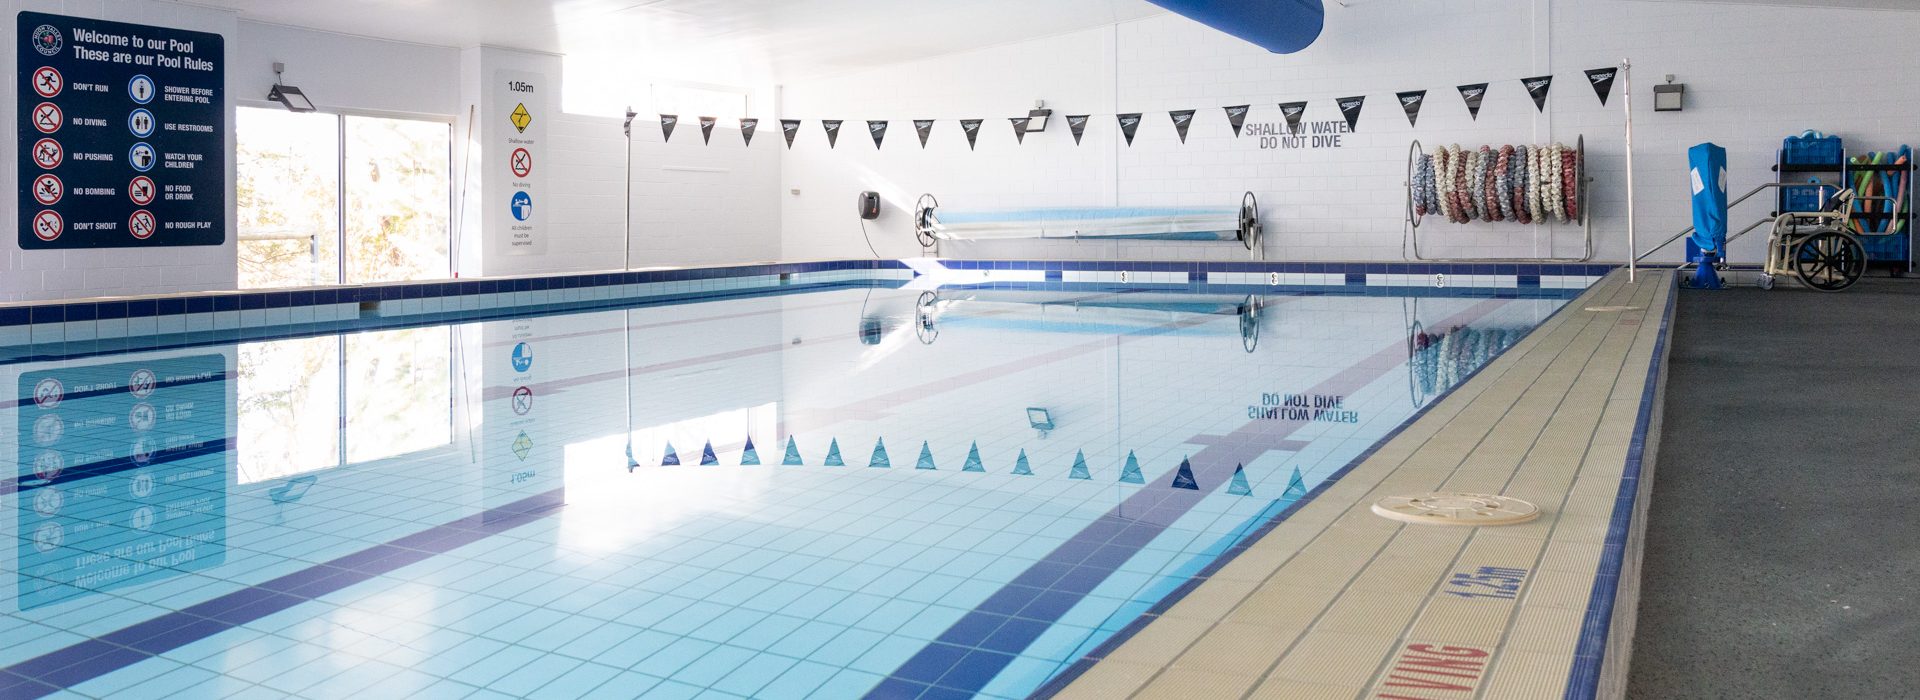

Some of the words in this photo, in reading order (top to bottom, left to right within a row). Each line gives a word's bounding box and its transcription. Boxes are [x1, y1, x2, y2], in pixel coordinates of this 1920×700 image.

[46, 26, 62, 41] VALLEY
[73, 28, 129, 46] Welcome
[132, 35, 144, 48] to
[148, 39, 167, 51] our
[170, 38, 194, 53] Pool
[36, 44, 60, 54] COUNCIL
[74, 46, 110, 61] These
[113, 51, 132, 64] are
[136, 54, 154, 66] our
[158, 55, 181, 69] Pool
[184, 57, 214, 71] Rules
[1590, 72, 1612, 80] speedo
[74, 82, 92, 92] DON'T
[95, 84, 108, 92] RUN
[165, 86, 189, 95] SHOWER
[191, 87, 214, 96] BEFORE
[508, 81, 534, 93] 1.05m
[164, 94, 193, 102] ENTERING
[195, 96, 210, 104] POOL
[73, 118, 82, 126] NO
[84, 118, 106, 126] DIVING
[178, 124, 214, 132] RESTROOMS
[1246, 122, 1307, 136] SHALLW
[1260, 136, 1278, 149] DO
[1282, 136, 1307, 148] NOT
[1312, 134, 1342, 148] DIVE
[74, 152, 83, 161] NO
[85, 152, 113, 161] PUSHING
[165, 153, 185, 161] WATCH
[165, 160, 194, 168] CHILDREN
[74, 188, 84, 196] NO
[85, 188, 115, 196] BOMBING
[165, 192, 174, 200] OR
[175, 192, 194, 200] DRINK
[74, 222, 93, 230] DON'T
[95, 222, 117, 230] SHOUT
[197, 221, 212, 229] PLAY
